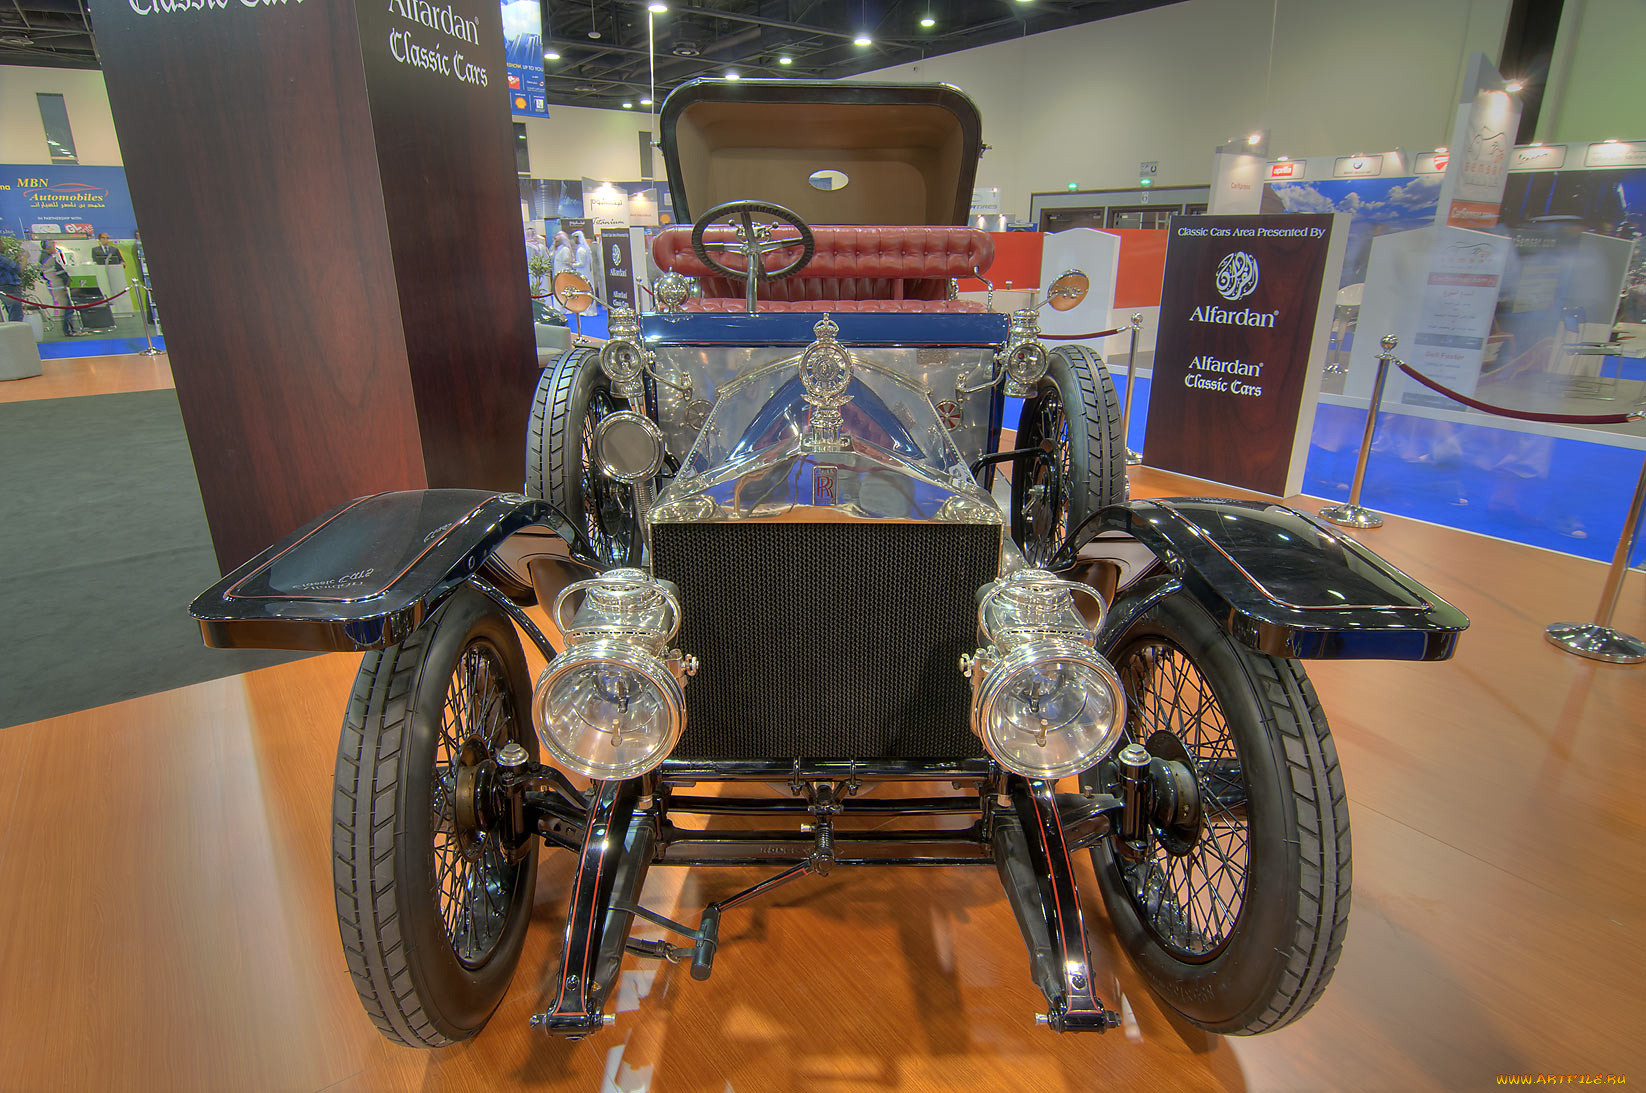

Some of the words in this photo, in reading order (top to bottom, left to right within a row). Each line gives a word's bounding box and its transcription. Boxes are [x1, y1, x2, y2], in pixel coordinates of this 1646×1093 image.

[389, 27, 450, 76] Classic
[453, 50, 488, 87] Cars
[17, 178, 49, 188] MBN
[29, 193, 104, 202] Automobiles
[1177, 227, 1209, 237] Classic
[1210, 227, 1232, 237] Cars
[1232, 227, 1256, 237] Area
[1257, 227, 1308, 237] Presented
[1310, 227, 1326, 239] By
[1189, 304, 1276, 328] Alfardan
[1188, 355, 1261, 377] Alfardan
[1184, 373, 1228, 392] Classic
[1230, 379, 1263, 397] Cars
[816, 475, 834, 499] RR
